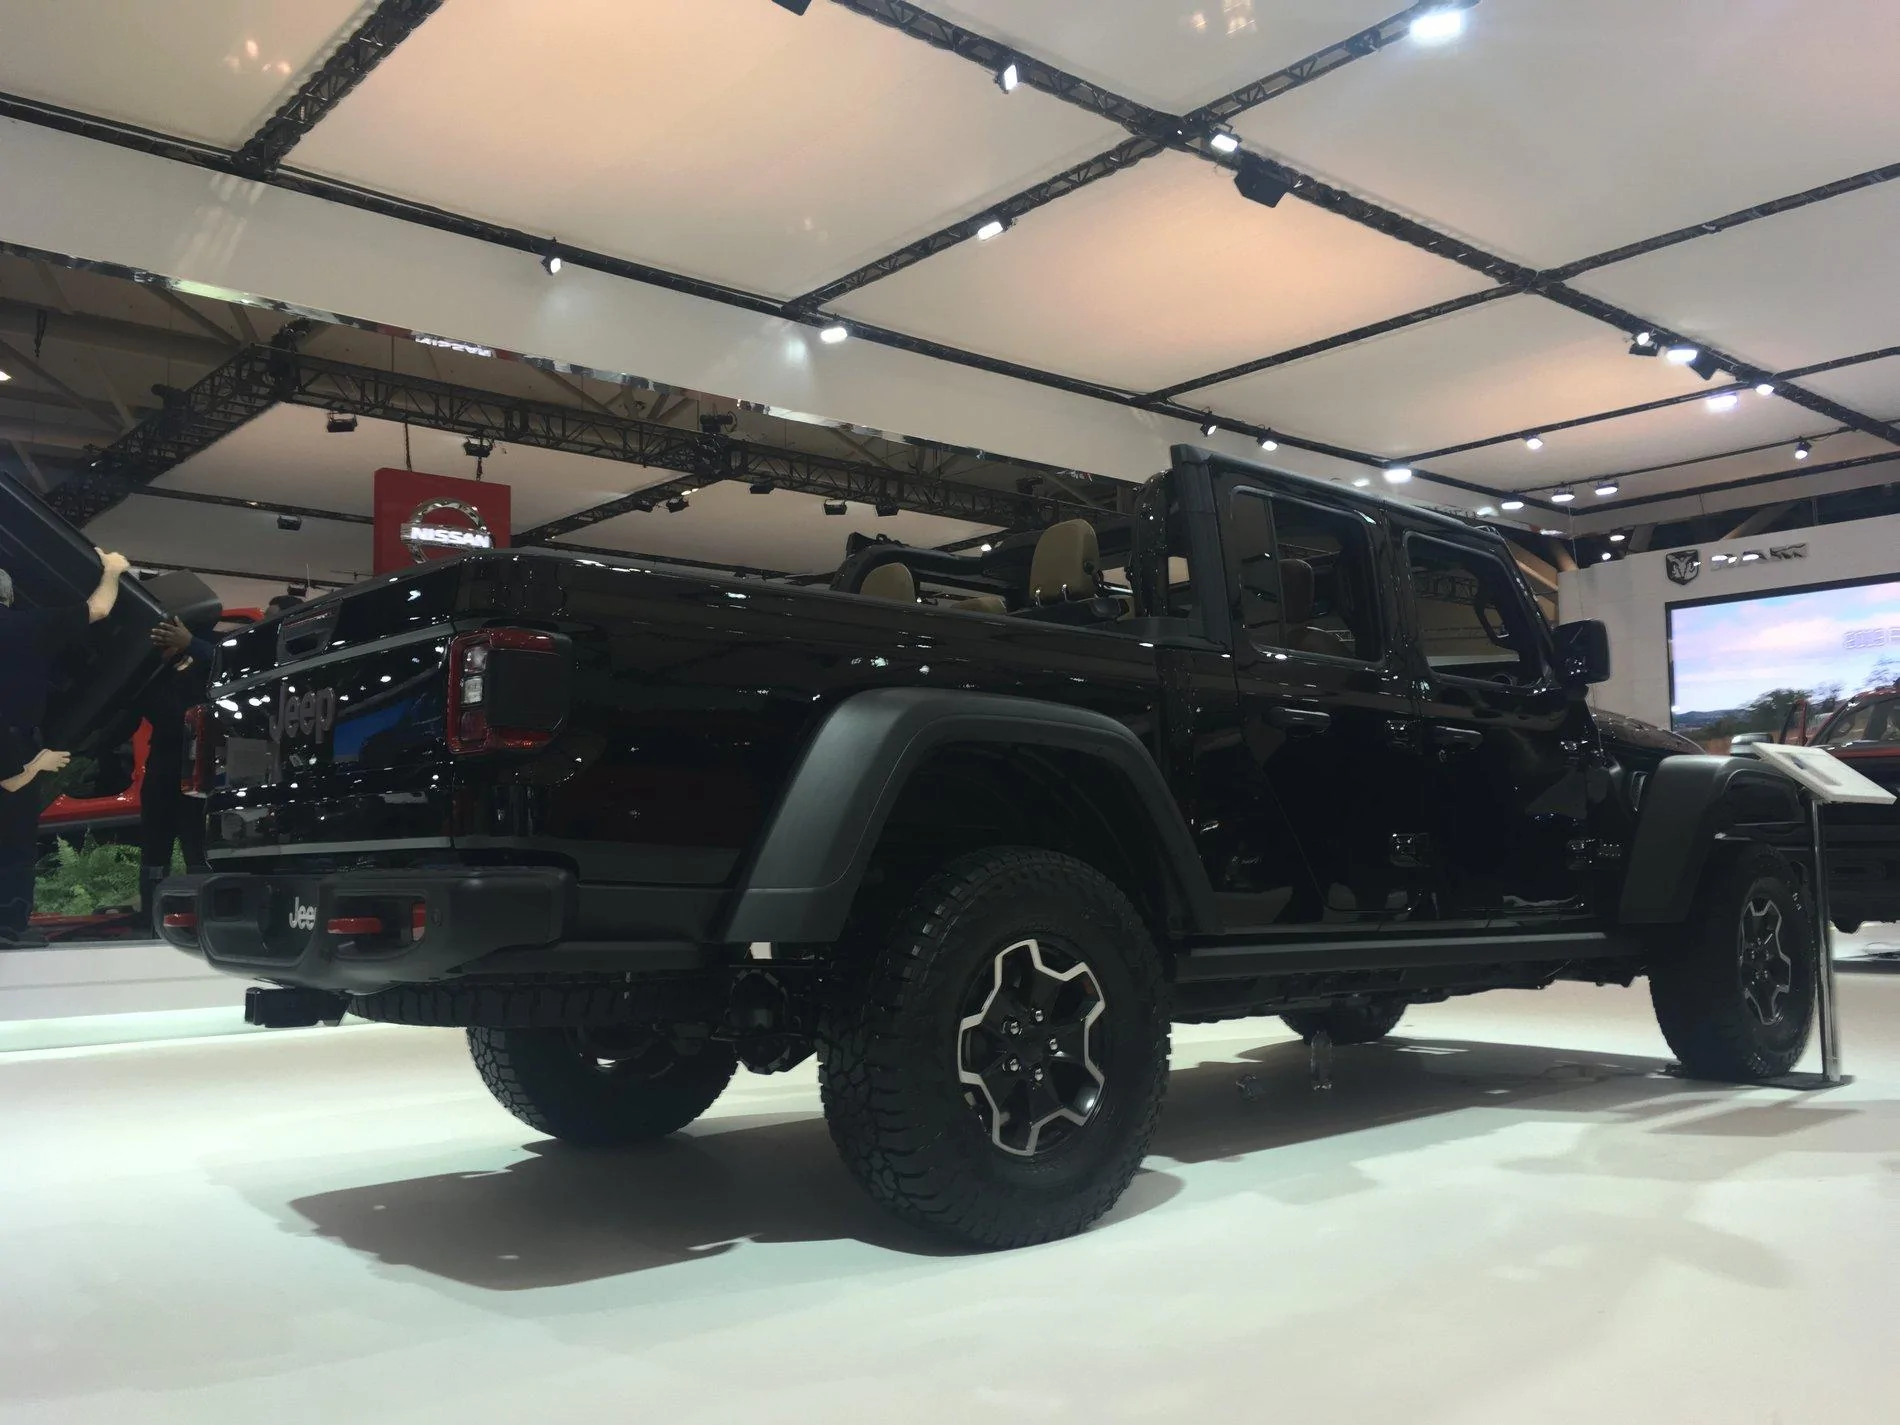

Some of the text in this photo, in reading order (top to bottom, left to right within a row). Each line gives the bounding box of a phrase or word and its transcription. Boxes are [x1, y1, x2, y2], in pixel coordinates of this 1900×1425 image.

[410, 526, 490, 548] NISSAN
[268, 680, 336, 744] Jeep
[288, 896, 317, 931] Jee
